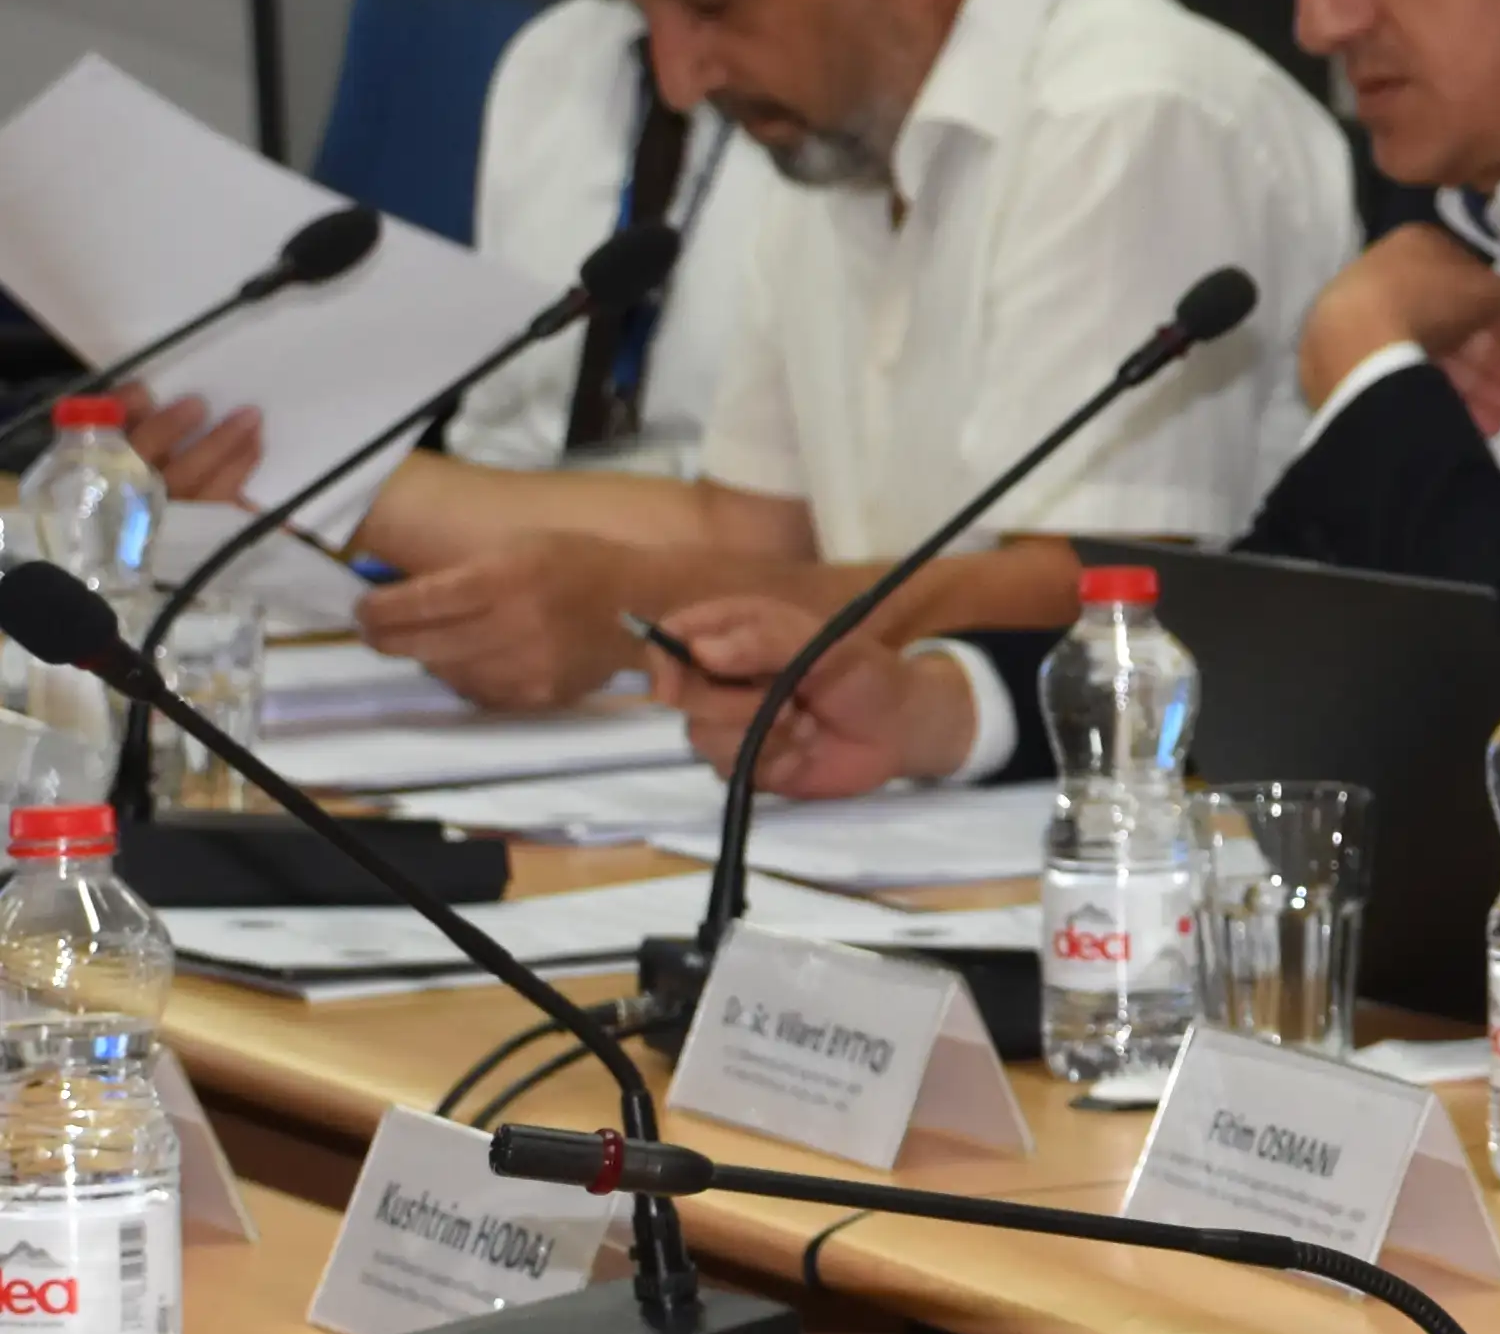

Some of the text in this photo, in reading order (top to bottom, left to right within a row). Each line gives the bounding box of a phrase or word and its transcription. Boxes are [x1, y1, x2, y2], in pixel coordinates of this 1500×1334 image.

[374, 1179, 473, 1252] Kushtrim
[471, 1213, 557, 1279] HODAJ
[0, 1267, 78, 1315] ea
